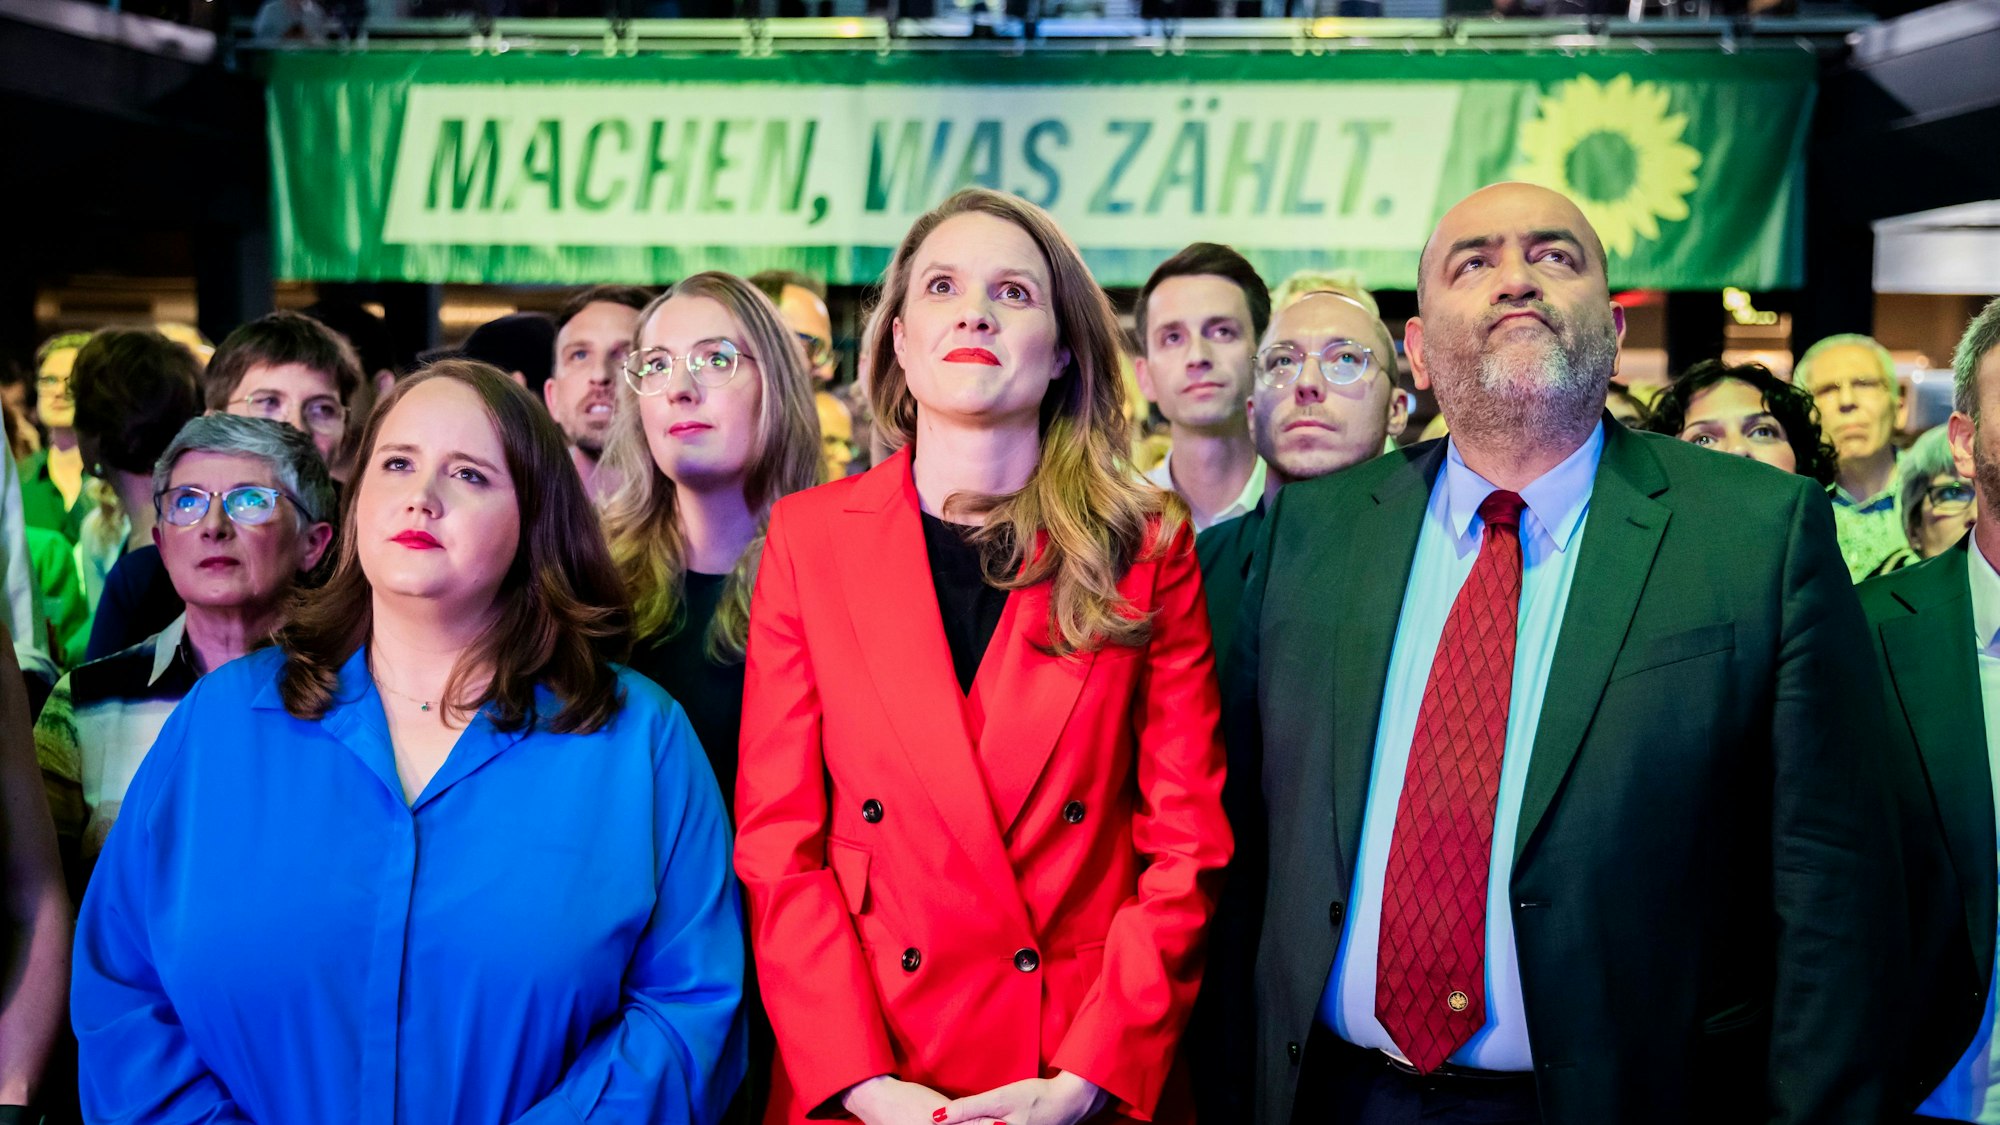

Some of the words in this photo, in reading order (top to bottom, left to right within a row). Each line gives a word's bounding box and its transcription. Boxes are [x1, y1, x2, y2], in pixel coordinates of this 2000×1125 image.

[424, 118, 830, 226] MACHEN,
[864, 119, 1070, 212] WAS
[1087, 97, 1395, 217] ZÄHLT.
